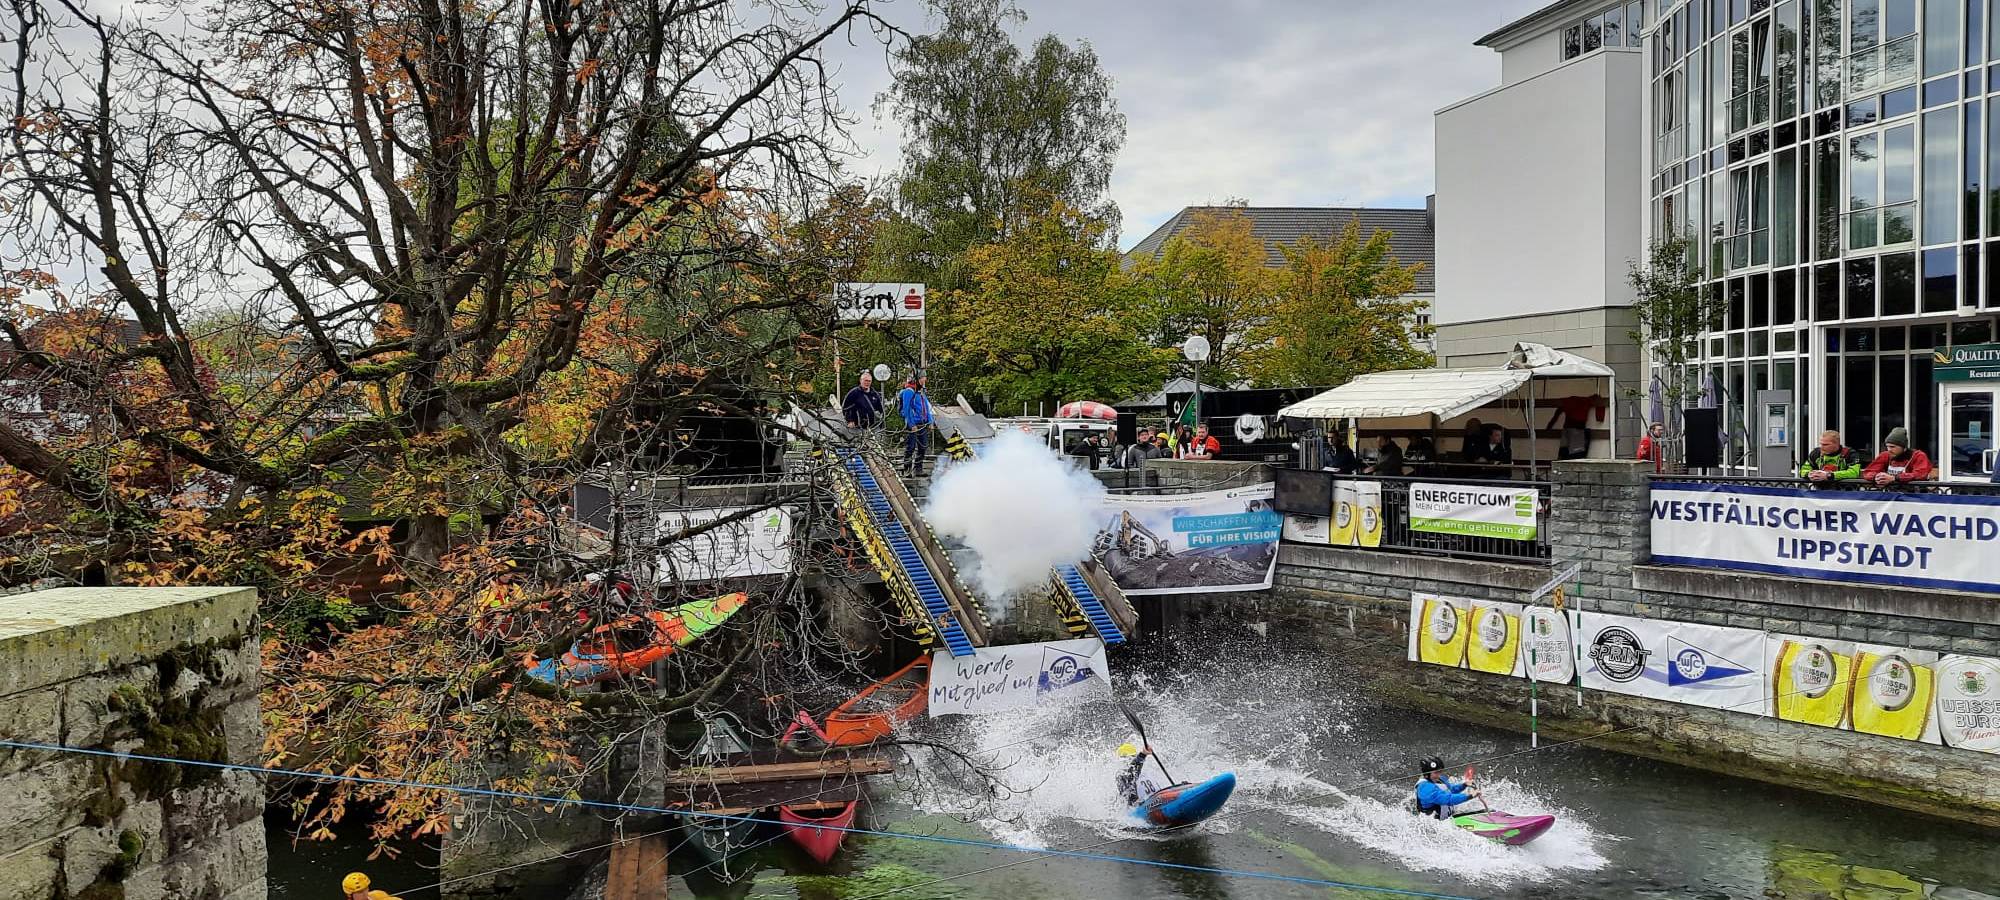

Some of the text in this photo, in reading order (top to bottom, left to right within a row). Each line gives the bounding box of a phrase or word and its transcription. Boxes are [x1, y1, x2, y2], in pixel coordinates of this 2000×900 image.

[1956, 349, 2000, 363] QUALITY
[1414, 489, 1511, 507] ENERGETICUM
[1177, 518, 1195, 530] WIR
[1199, 516, 1248, 528] SCHAFFEN
[1415, 519, 1530, 535] www.energeticum.de
[1650, 497, 1999, 541] WESTFÄLISCHER WACHD
[1192, 530, 1278, 545] FÜR IHRE VISION
[1777, 537, 1933, 569] LIPPSTADT
[1587, 643, 1652, 666] SPRINT
[958, 654, 1014, 680] Werde
[934, 674, 1008, 709] Mitglied
[1955, 714, 2000, 728] BURG
